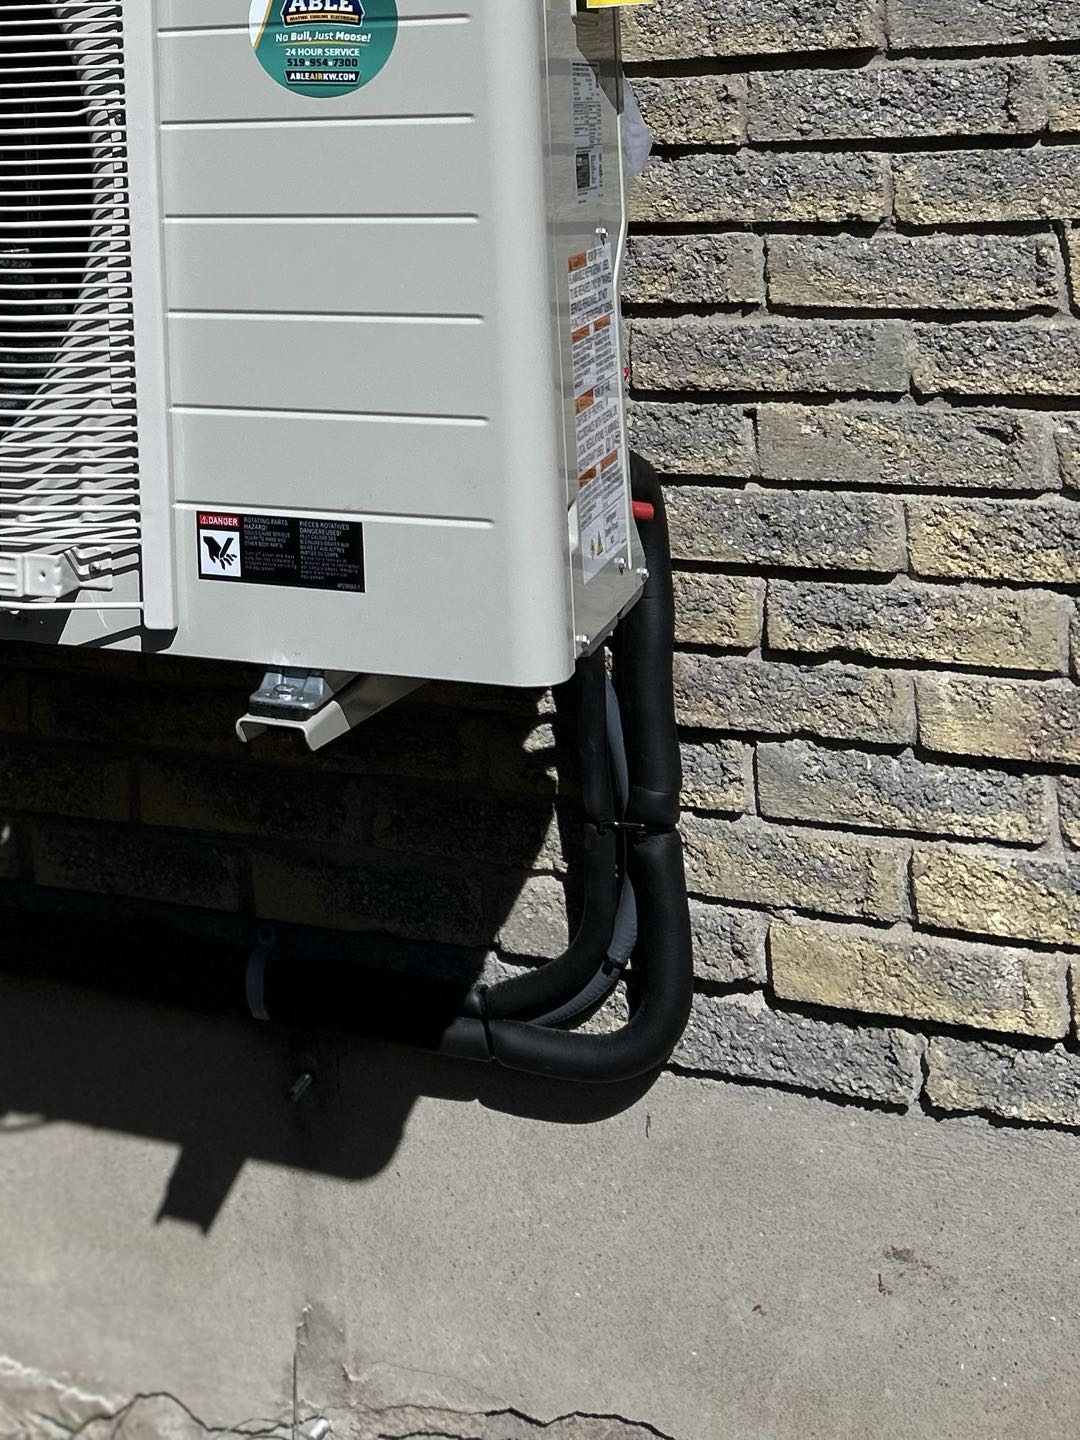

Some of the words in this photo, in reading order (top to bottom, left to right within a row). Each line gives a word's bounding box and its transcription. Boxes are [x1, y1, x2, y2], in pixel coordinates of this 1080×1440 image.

[276, 34, 288, 42] No
[290, 32, 312, 42] Bull,
[313, 32, 334, 41] Just
[335, 32, 372, 43] Moose!
[285, 48, 296, 56] 24
[297, 48, 323, 56] HOUR
[324, 48, 360, 56] SERVICE
[290, 72, 356, 81] ABLEAIRKW.COM
[208, 516, 239, 527] DANGER
